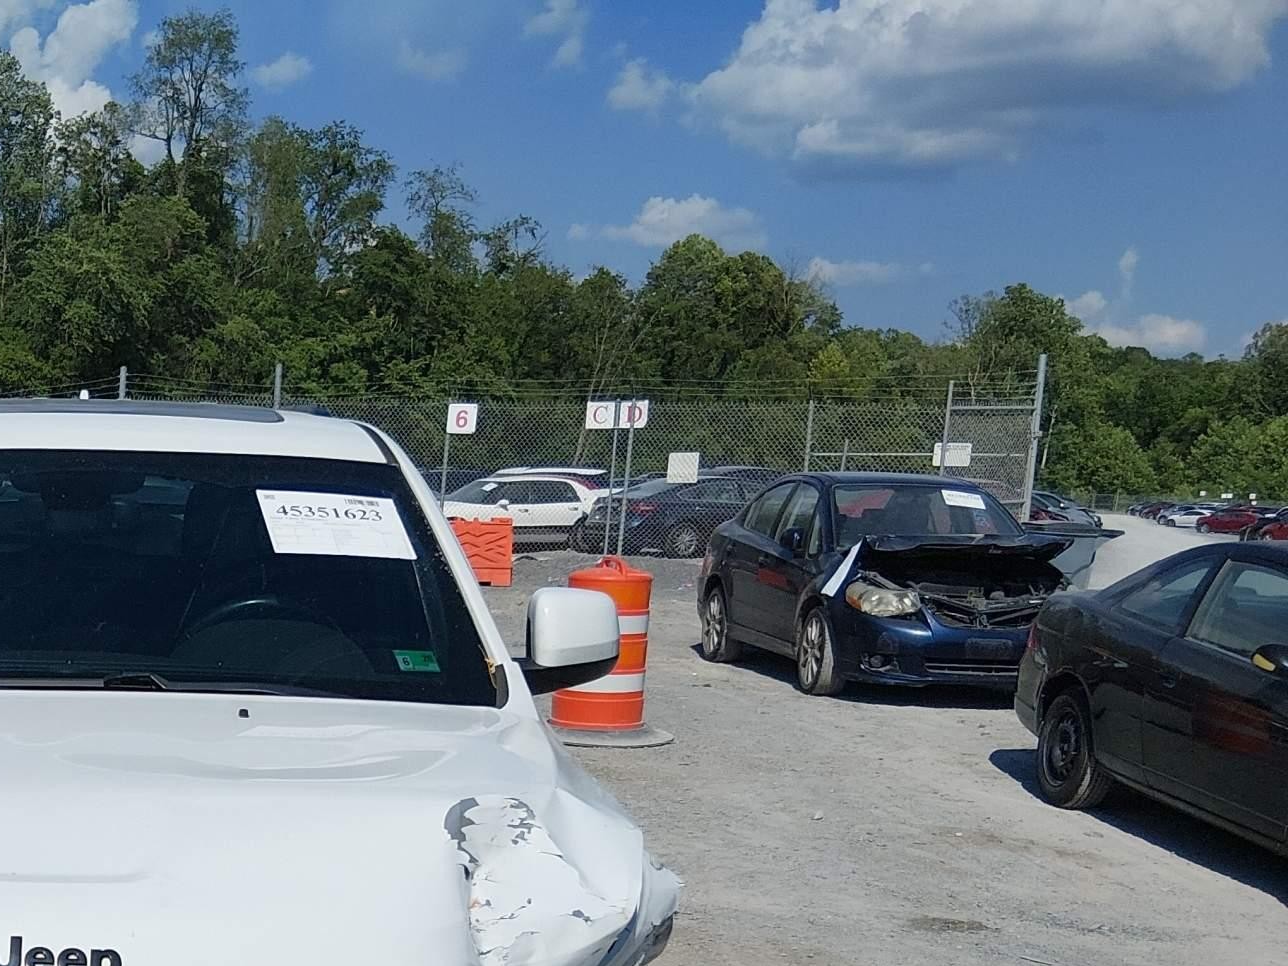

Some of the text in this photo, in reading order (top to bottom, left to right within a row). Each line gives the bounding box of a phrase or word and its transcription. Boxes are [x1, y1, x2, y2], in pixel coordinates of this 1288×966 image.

[455, 409, 468, 429] 6
[592, 405, 609, 425] C
[626, 405, 643, 425] D
[275, 504, 383, 522] 45351623
[402, 656, 411, 666] 6
